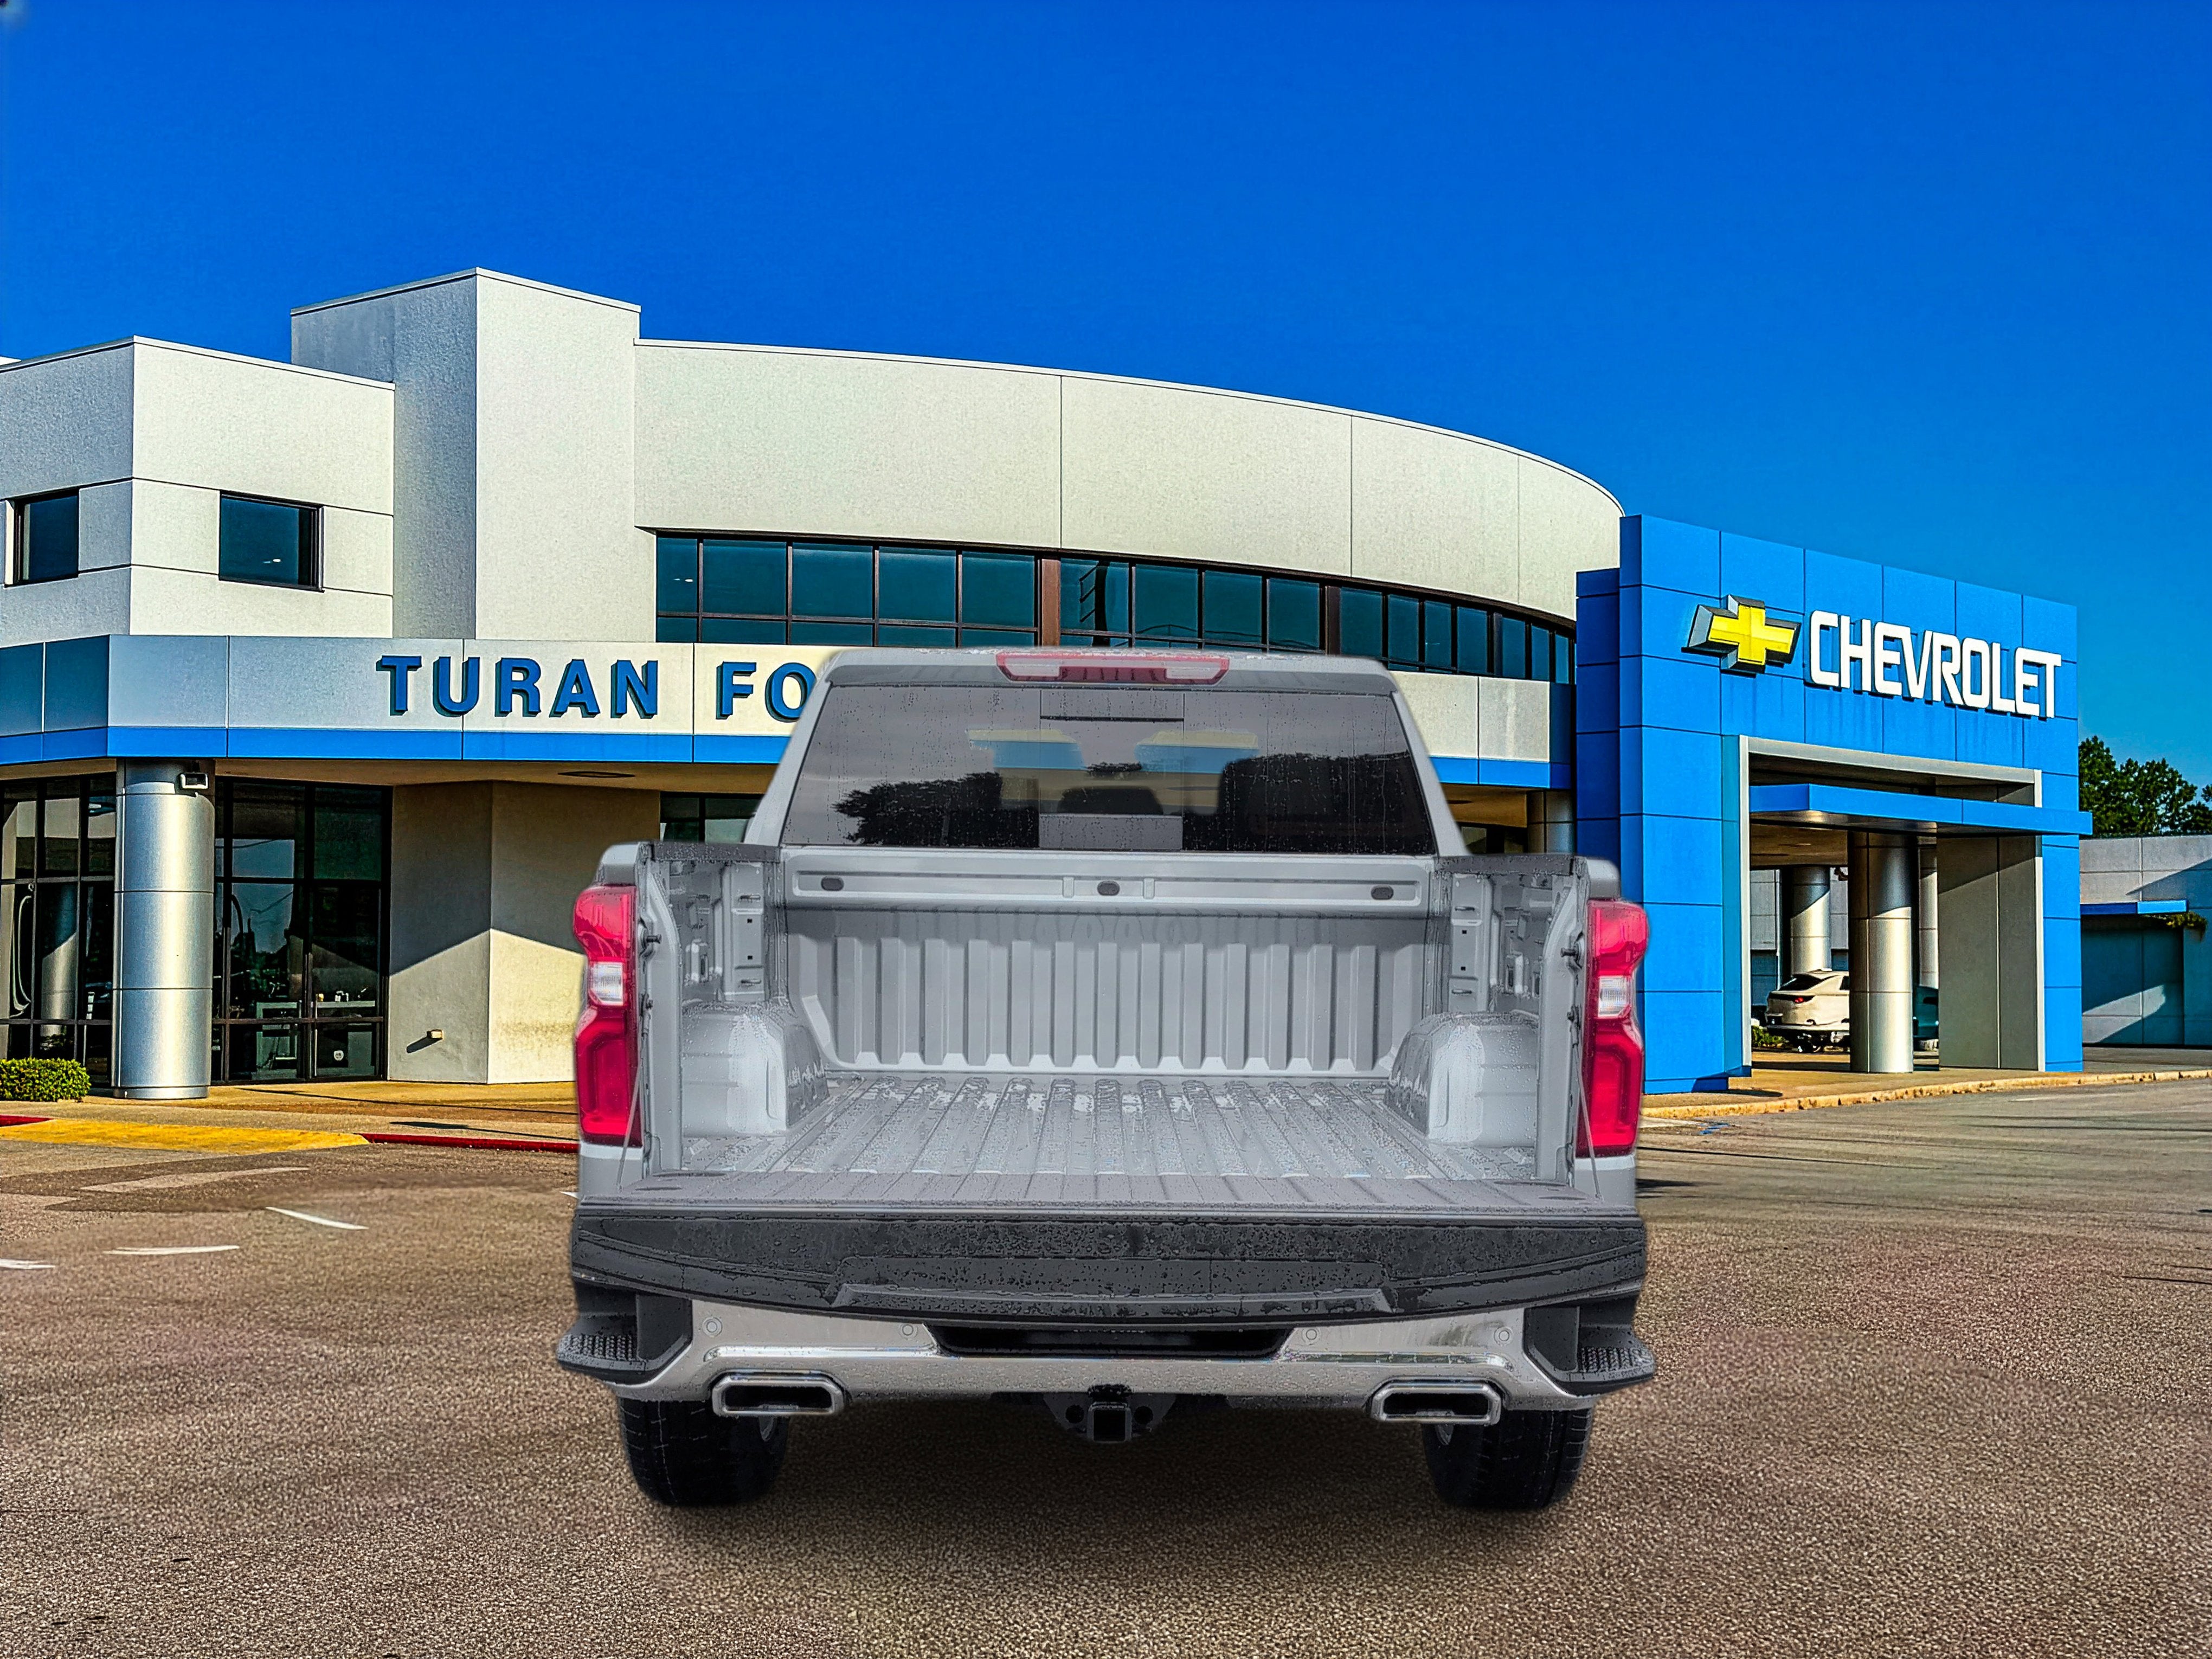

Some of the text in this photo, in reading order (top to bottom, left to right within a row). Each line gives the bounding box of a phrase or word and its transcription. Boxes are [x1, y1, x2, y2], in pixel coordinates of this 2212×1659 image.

[376, 655, 816, 723] TURAN FO
[1810, 610, 2062, 718] CHEVROLET
